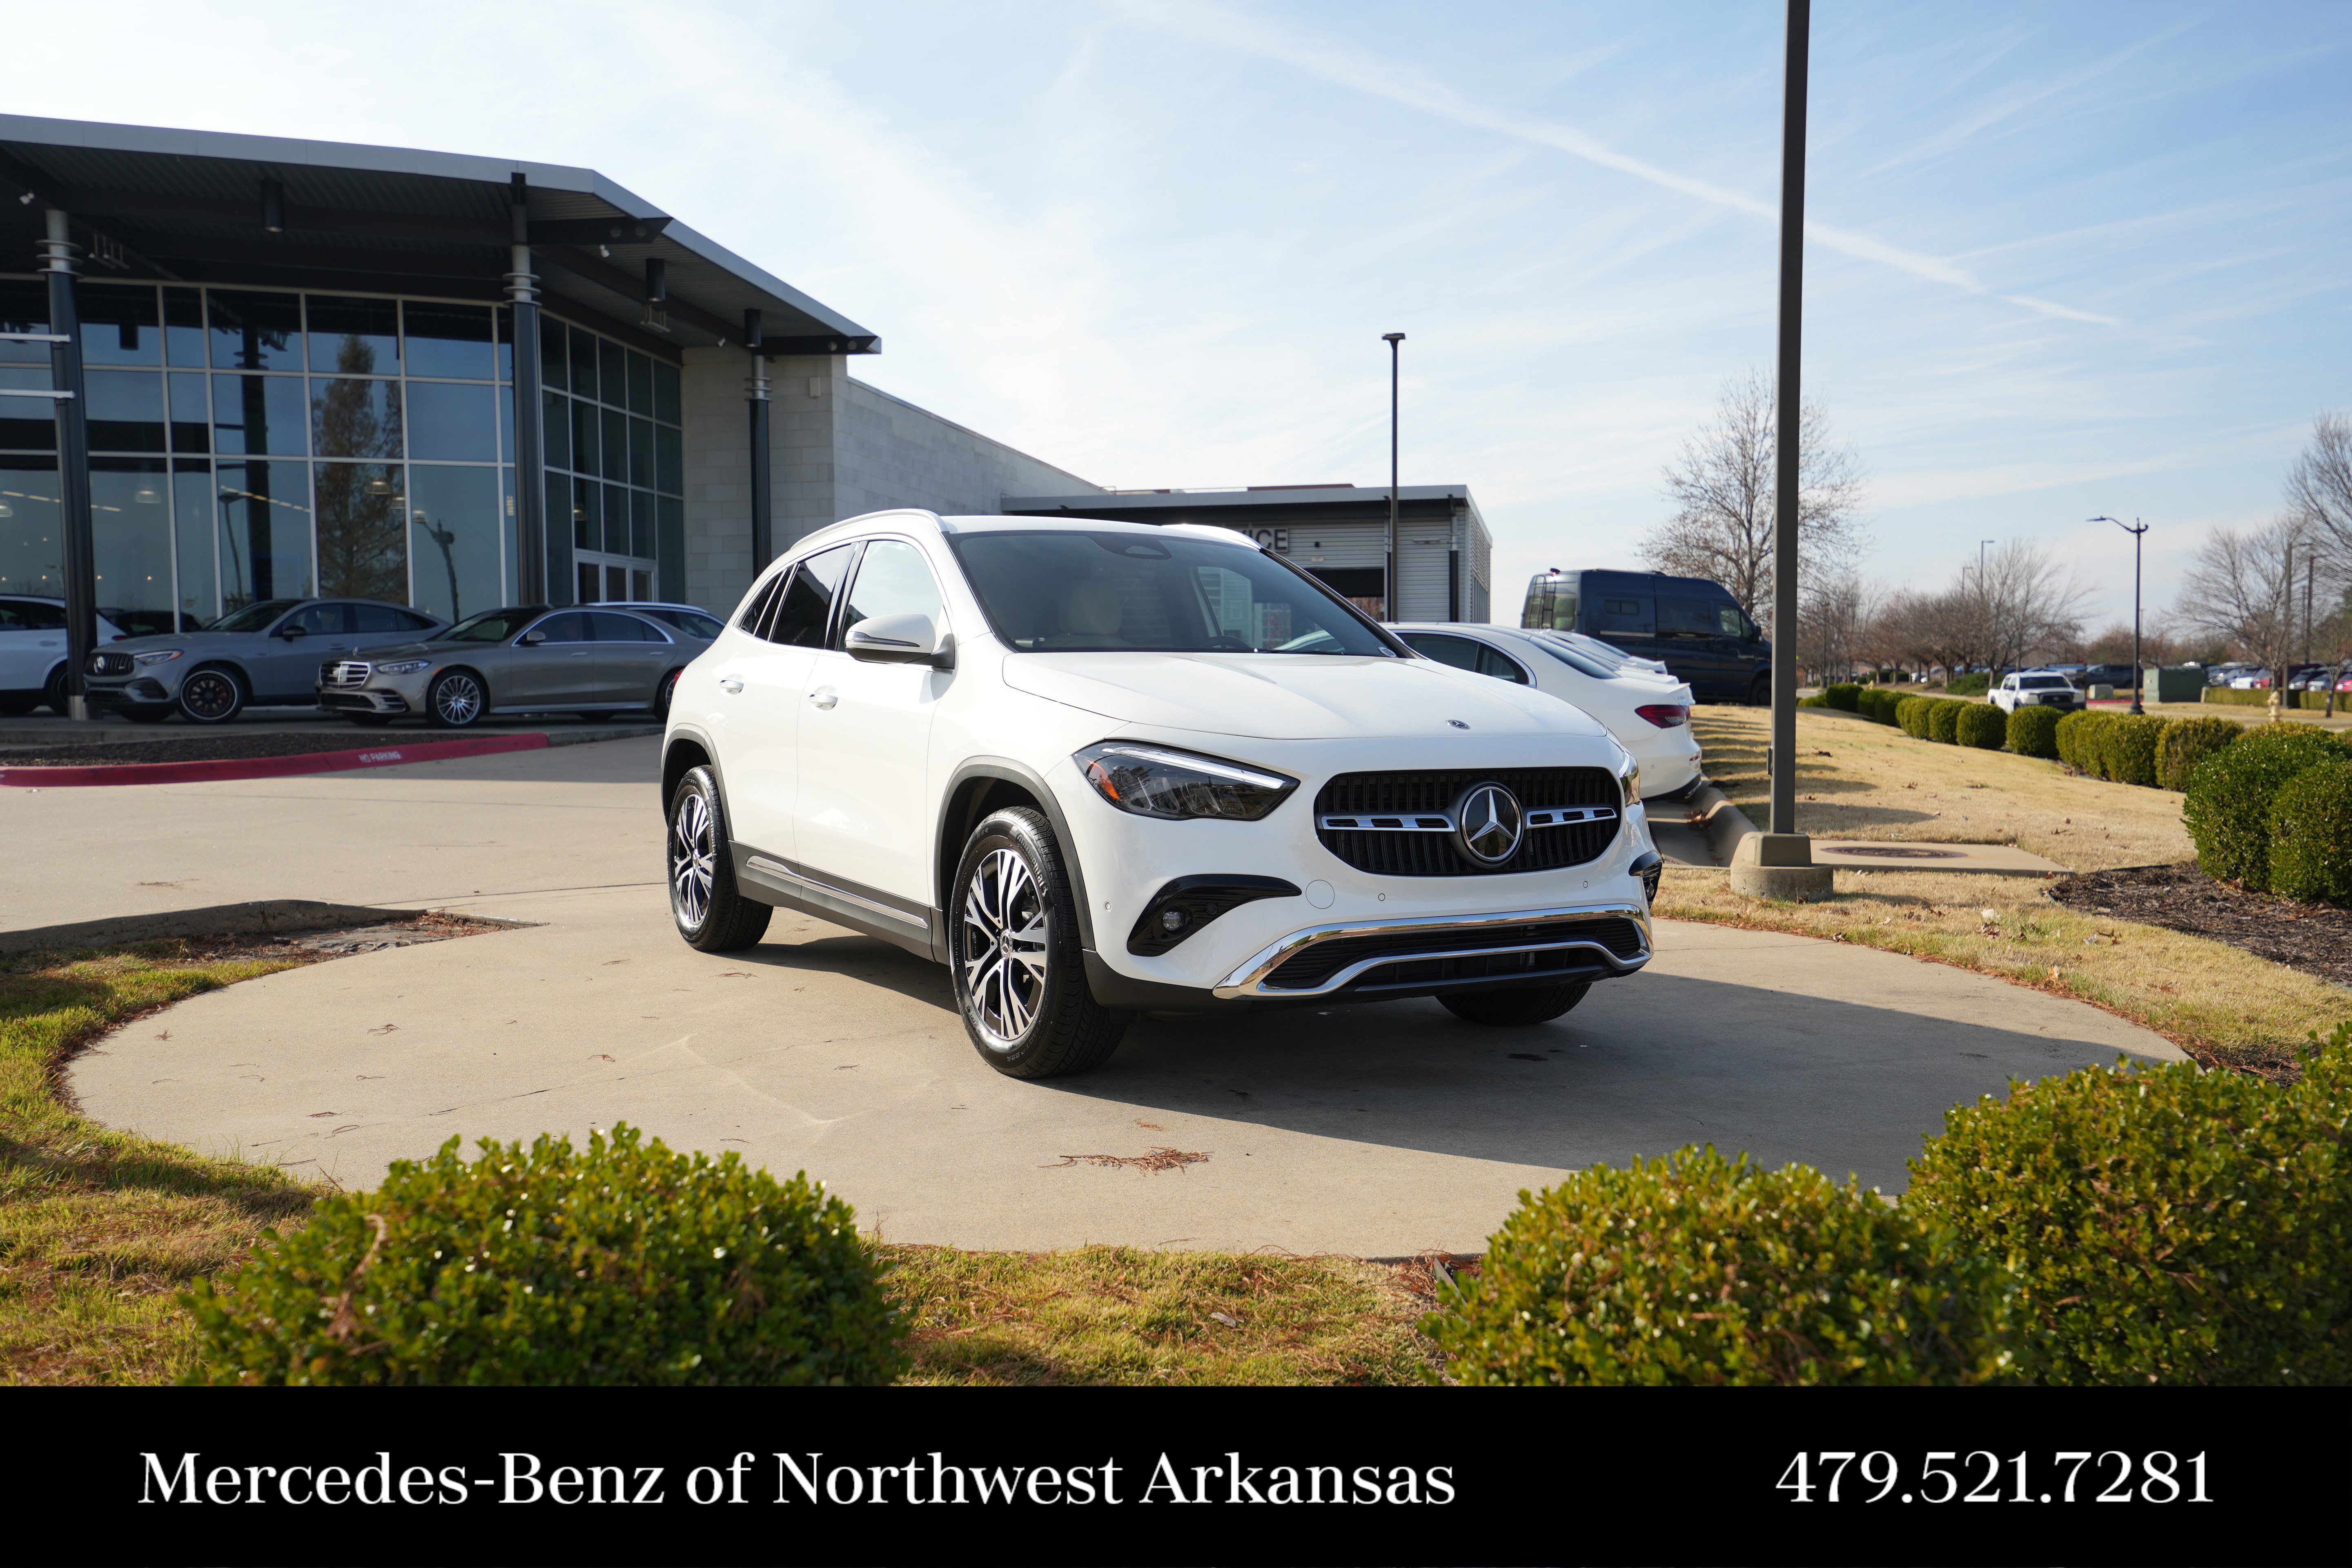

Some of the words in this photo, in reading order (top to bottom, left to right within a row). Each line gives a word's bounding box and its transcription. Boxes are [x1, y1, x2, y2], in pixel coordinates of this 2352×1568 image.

[359, 754, 371, 763] NO
[370, 751, 401, 762] PARKING
[1015, 833, 1046, 888] Continental
